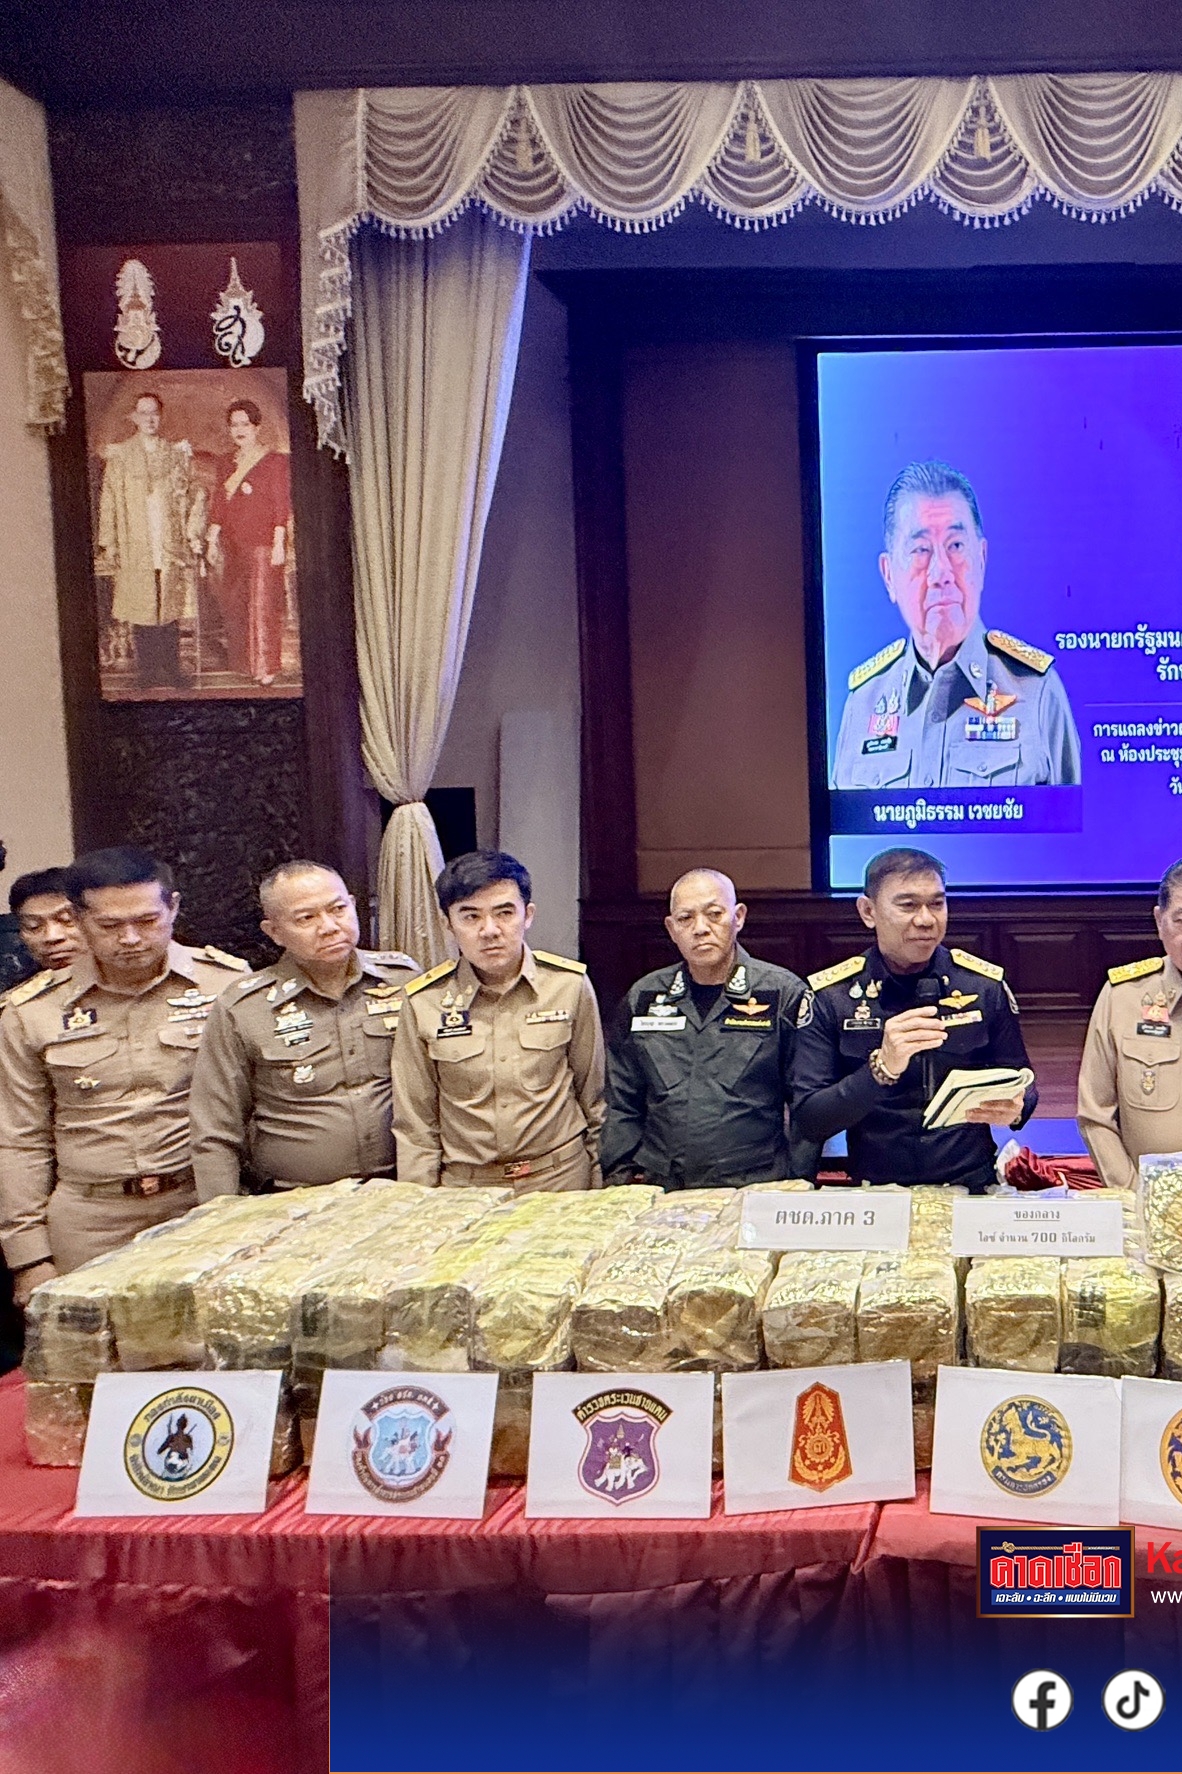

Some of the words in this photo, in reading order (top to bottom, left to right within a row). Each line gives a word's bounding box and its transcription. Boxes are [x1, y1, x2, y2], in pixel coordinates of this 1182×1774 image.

[1101, 750, 1115, 763] ณ
[874, 798, 964, 829] นายภูมิธรรม
[968, 797, 1024, 819] เวชยชัย
[775, 1208, 855, 1226] ตชด.ภาค
[863, 1210, 875, 1226] 3
[1013, 1208, 1060, 1222] ของกลาง
[978, 1231, 996, 1244] ไอซ์
[999, 1234, 1028, 1244] จำนวน
[1032, 1232, 1057, 1244] 700
[1061, 1232, 1096, 1244] กิโลกรัม
